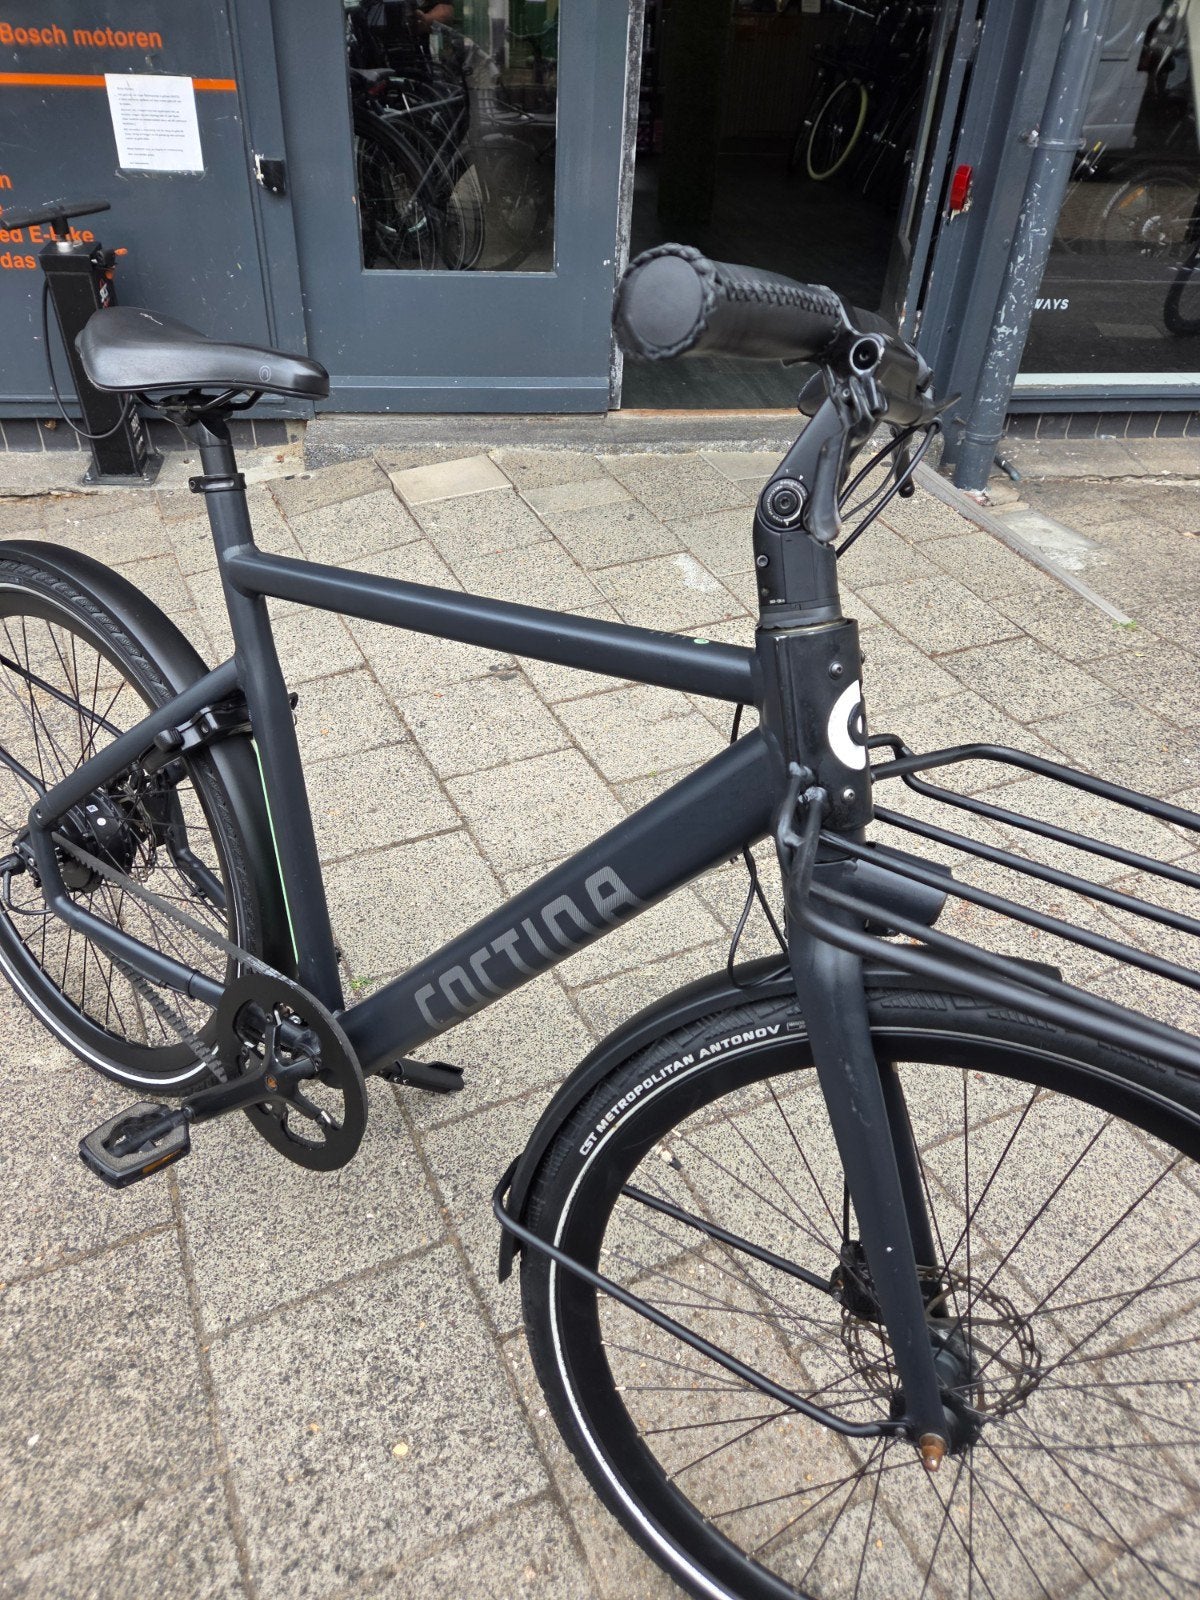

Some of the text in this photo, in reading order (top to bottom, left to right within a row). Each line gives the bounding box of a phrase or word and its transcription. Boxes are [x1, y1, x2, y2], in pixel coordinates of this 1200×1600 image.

[0, 22, 163, 48] Bosch motoren
[29, 225, 94, 242] E-ke
[0, 252, 36, 269] das
[579, 1024, 781, 1156] CST METROPOLITAN ANTONOV
